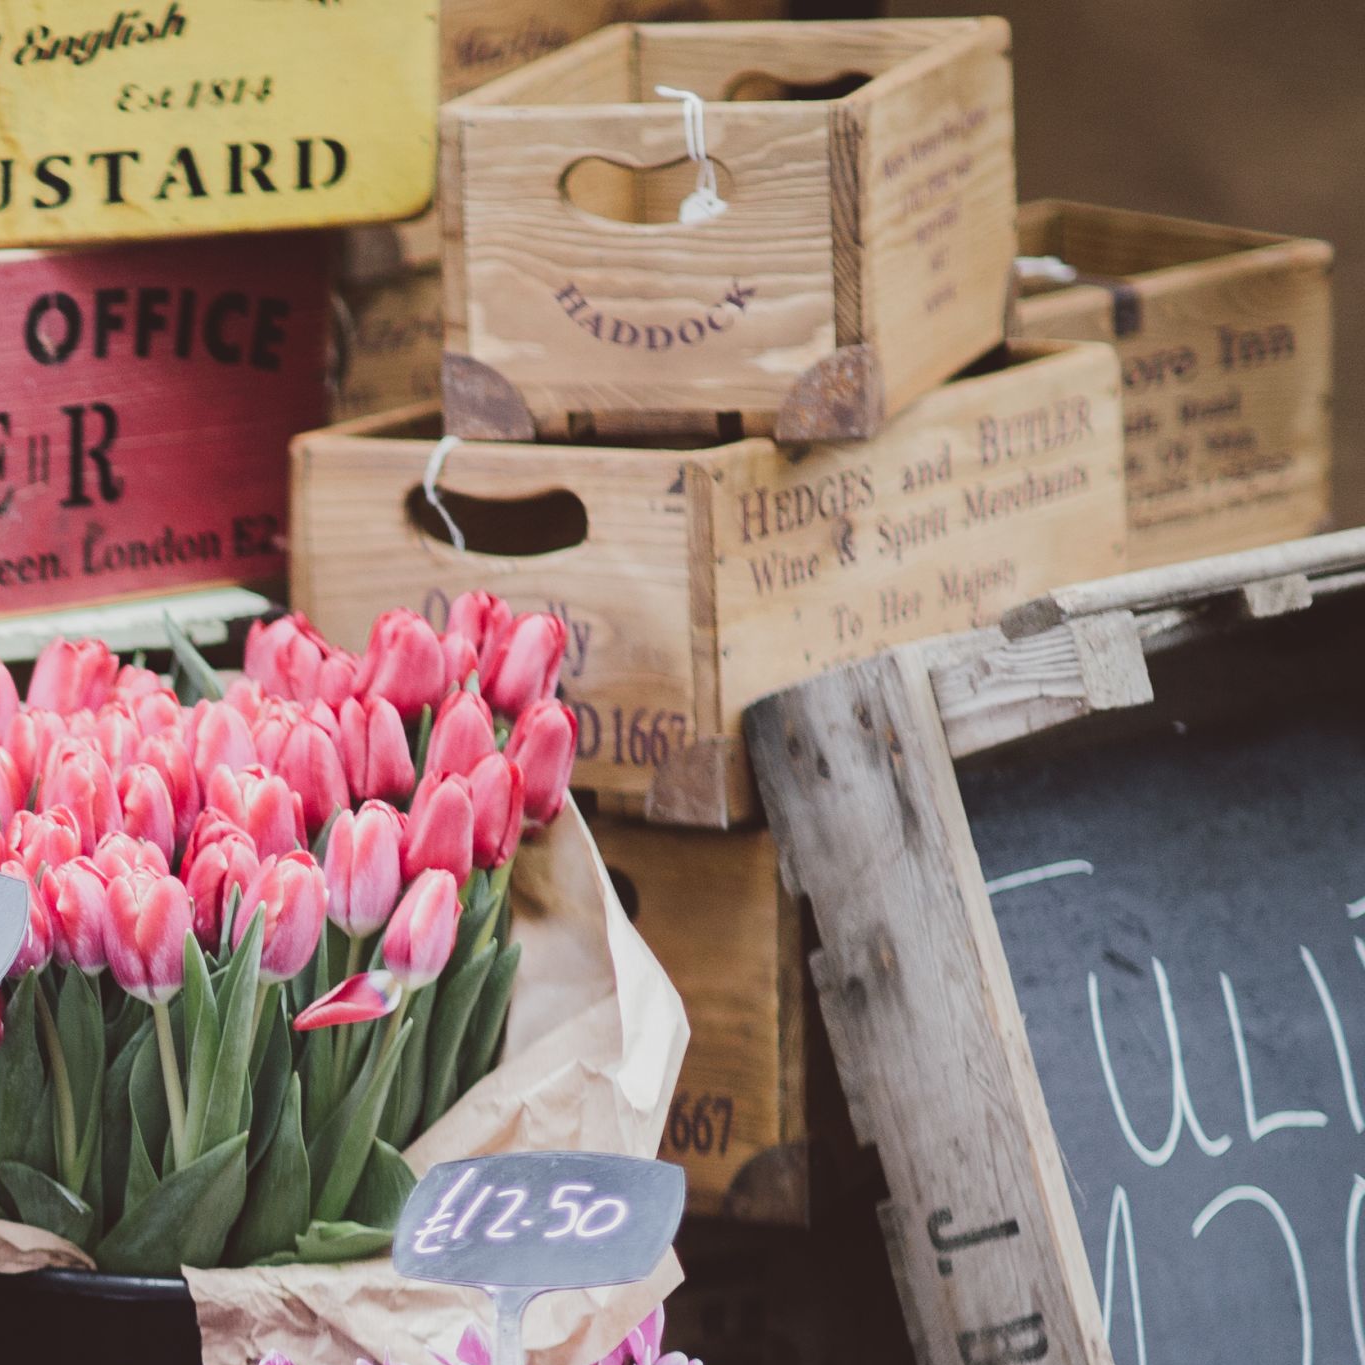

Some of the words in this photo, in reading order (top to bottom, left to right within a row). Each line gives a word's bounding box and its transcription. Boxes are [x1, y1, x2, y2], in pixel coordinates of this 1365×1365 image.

[13, 5, 188, 67] English
[23, 286, 292, 373] OFFICE
[555, 277, 758, 353] HADDOCK
[737, 463, 878, 544] HEDGES
[902, 438, 953, 494] and
[978, 397, 1094, 468] BUTLER
[81, 522, 222, 577] London
[747, 550, 821, 599] Wine
[833, 514, 859, 567] &
[875, 504, 949, 564] Spirit
[961, 462, 1090, 528] Merchants
[831, 605, 864, 643] To
[877, 590, 922, 629] Her
[938, 554, 1018, 609] Majesty
[413, 1166, 628, 1254] £12.50
